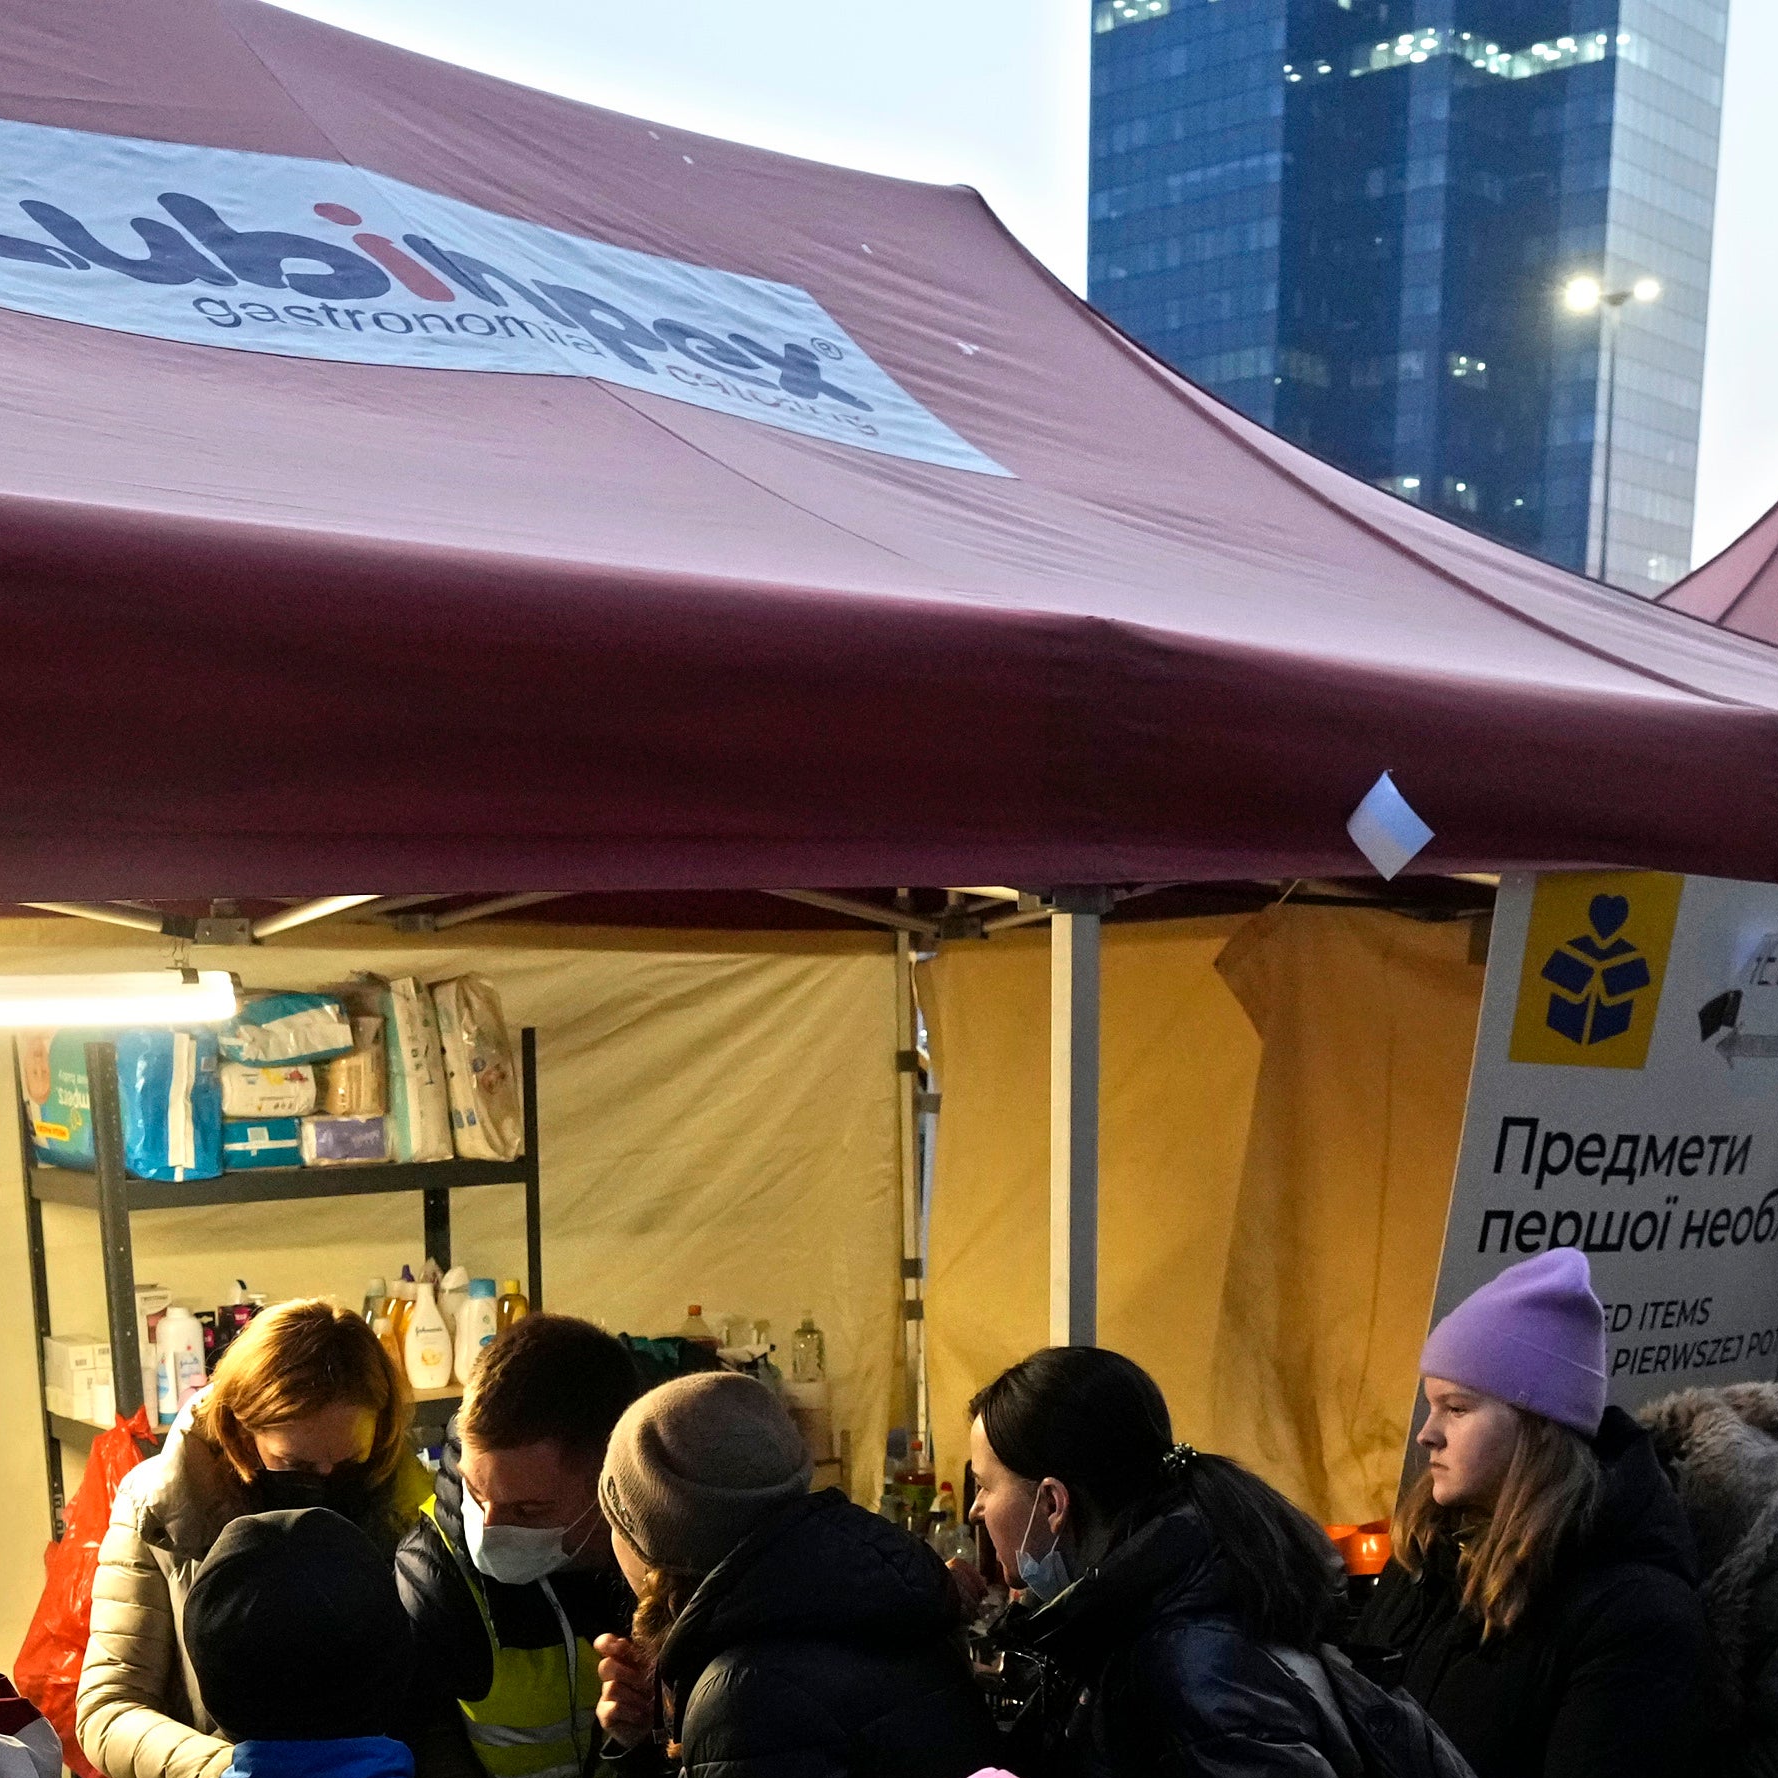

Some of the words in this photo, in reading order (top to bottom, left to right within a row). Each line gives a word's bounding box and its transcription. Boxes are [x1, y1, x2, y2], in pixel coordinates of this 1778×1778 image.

[192, 296, 607, 358] gastronomia
[1493, 1116, 1754, 1190] Предмети
[1477, 1196, 1680, 1253] першої
[1638, 1297, 1713, 1330] ITEMS
[1611, 1334, 1744, 1378] PIERWSZEJ
